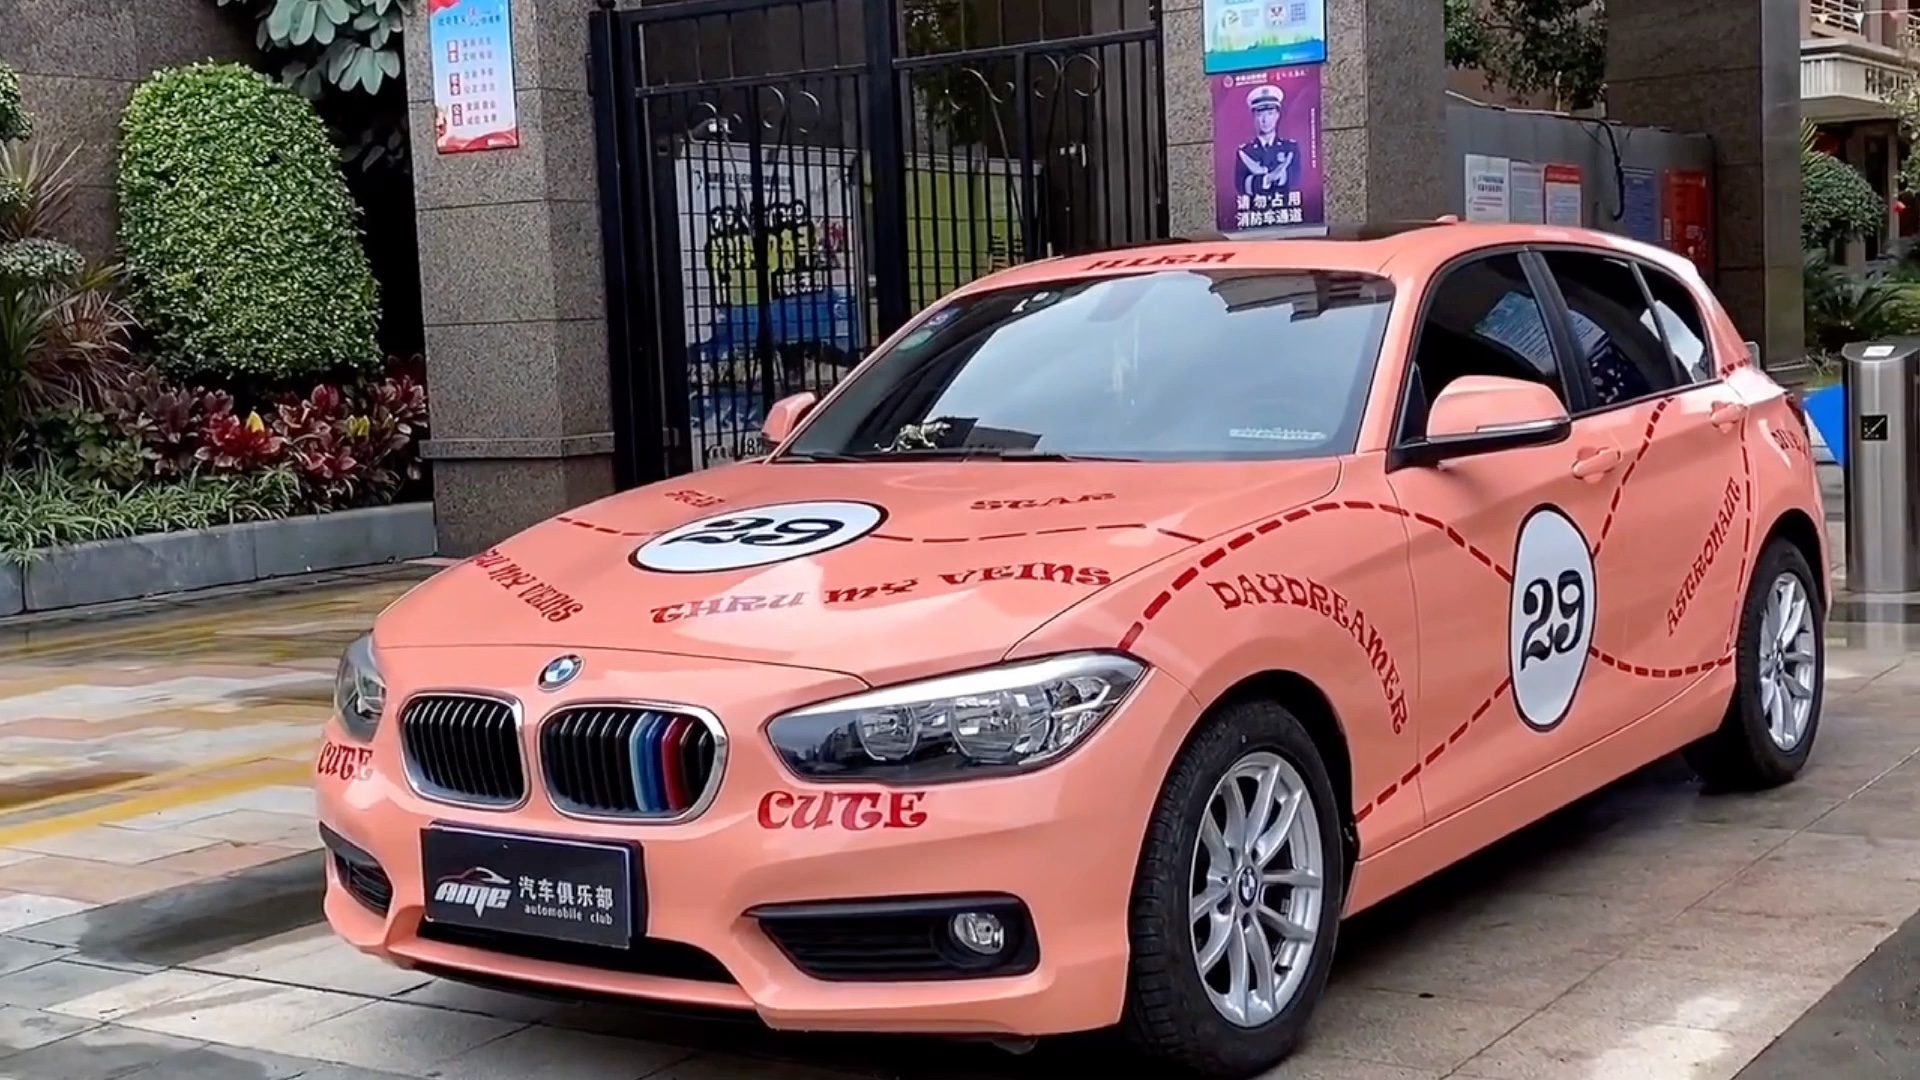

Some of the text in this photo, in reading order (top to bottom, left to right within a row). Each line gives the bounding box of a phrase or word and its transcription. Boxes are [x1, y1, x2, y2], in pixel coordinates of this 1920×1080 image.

[1235, 208, 1303, 228] 消防车通道
[1237, 191, 1301, 210] 请勿占用
[660, 517, 845, 546] 29
[650, 562, 1112, 624] THRU MY VEINS
[1520, 569, 1585, 671] 29
[1207, 573, 1409, 735] DAYDREAMER
[318, 741, 373, 781] CUTE
[757, 790, 928, 831] CUTE
[518, 876, 614, 911] 汽车俱乐部
[524, 903, 613, 926] automobile club
